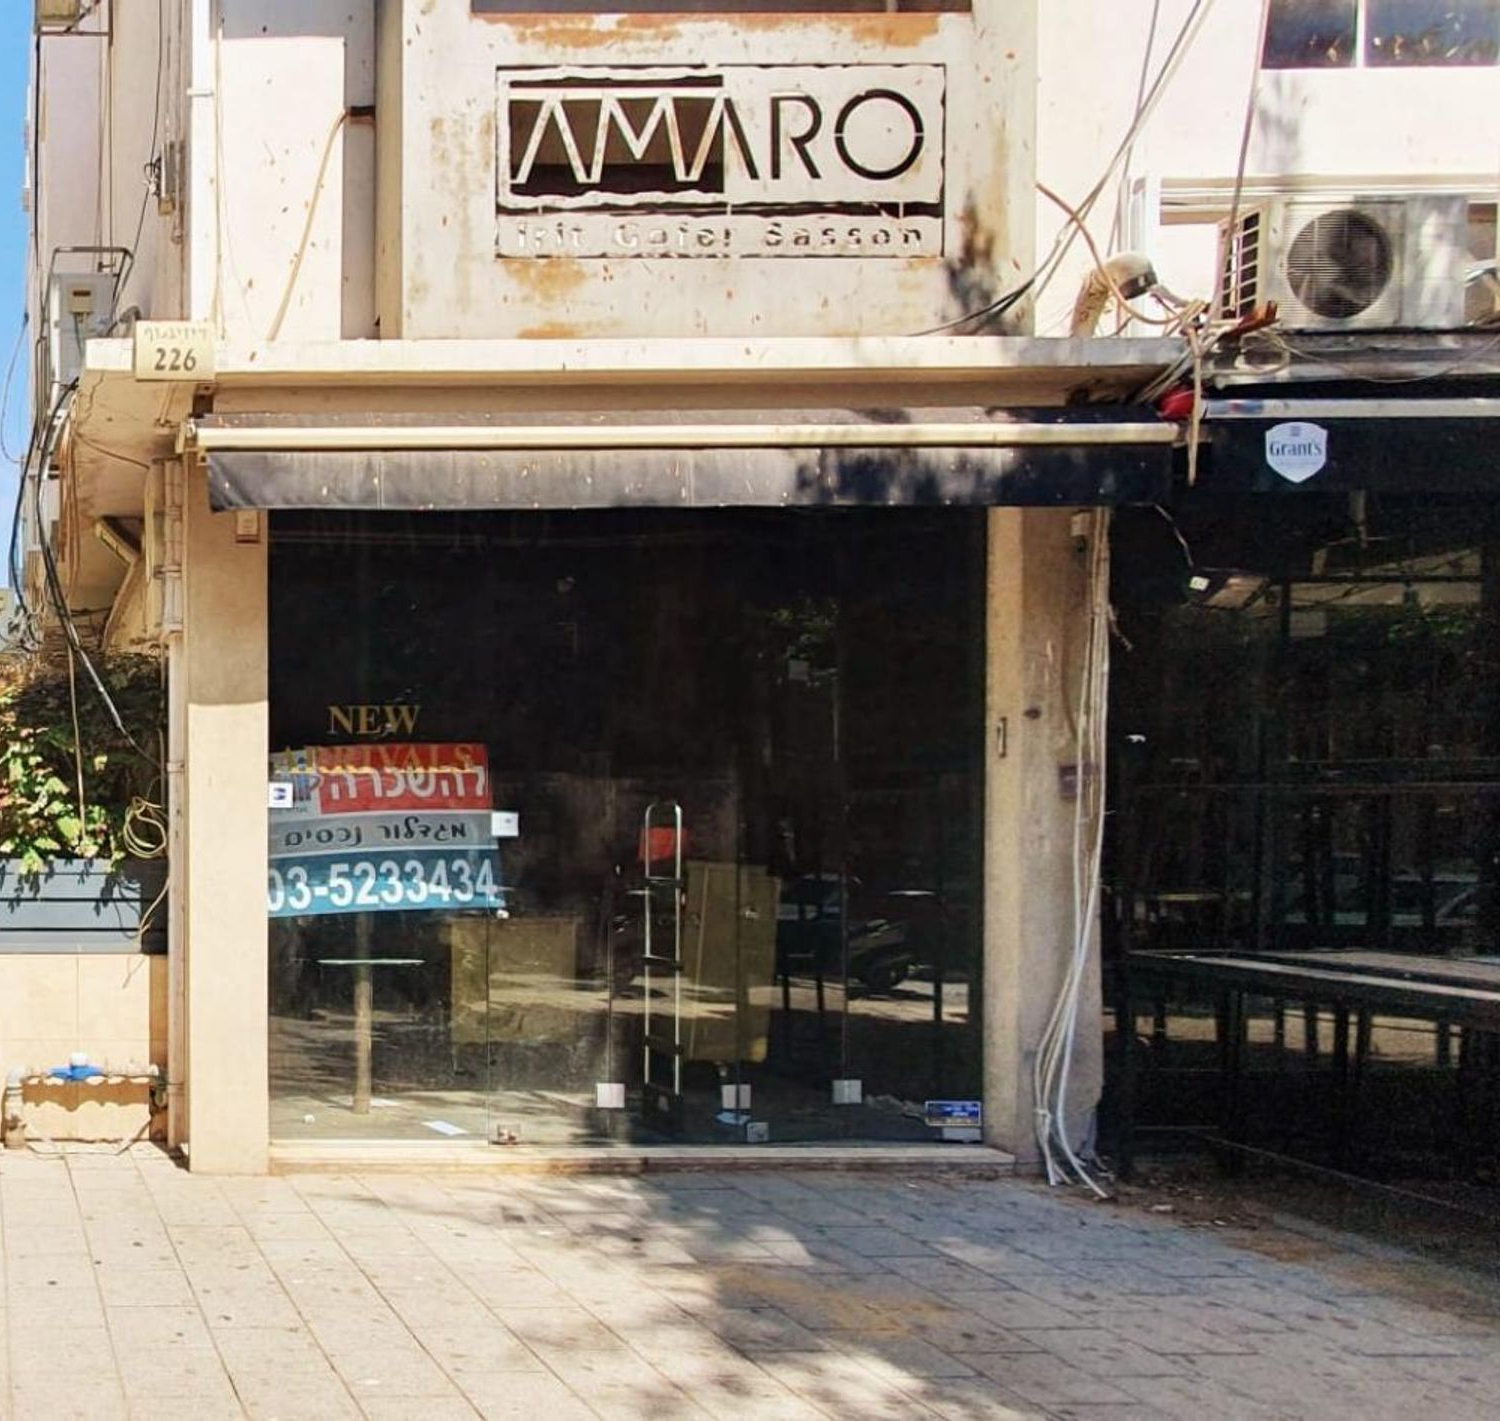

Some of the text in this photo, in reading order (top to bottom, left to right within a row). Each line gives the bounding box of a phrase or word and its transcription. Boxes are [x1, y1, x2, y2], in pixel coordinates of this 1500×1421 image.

[510, 88, 925, 184] AMARO
[153, 347, 197, 372] 226
[328, 704, 421, 735] NEW
[326, 764, 486, 800] להשכרה
[376, 815, 467, 840] מגדלור
[268, 859, 499, 911] 03-5233434
